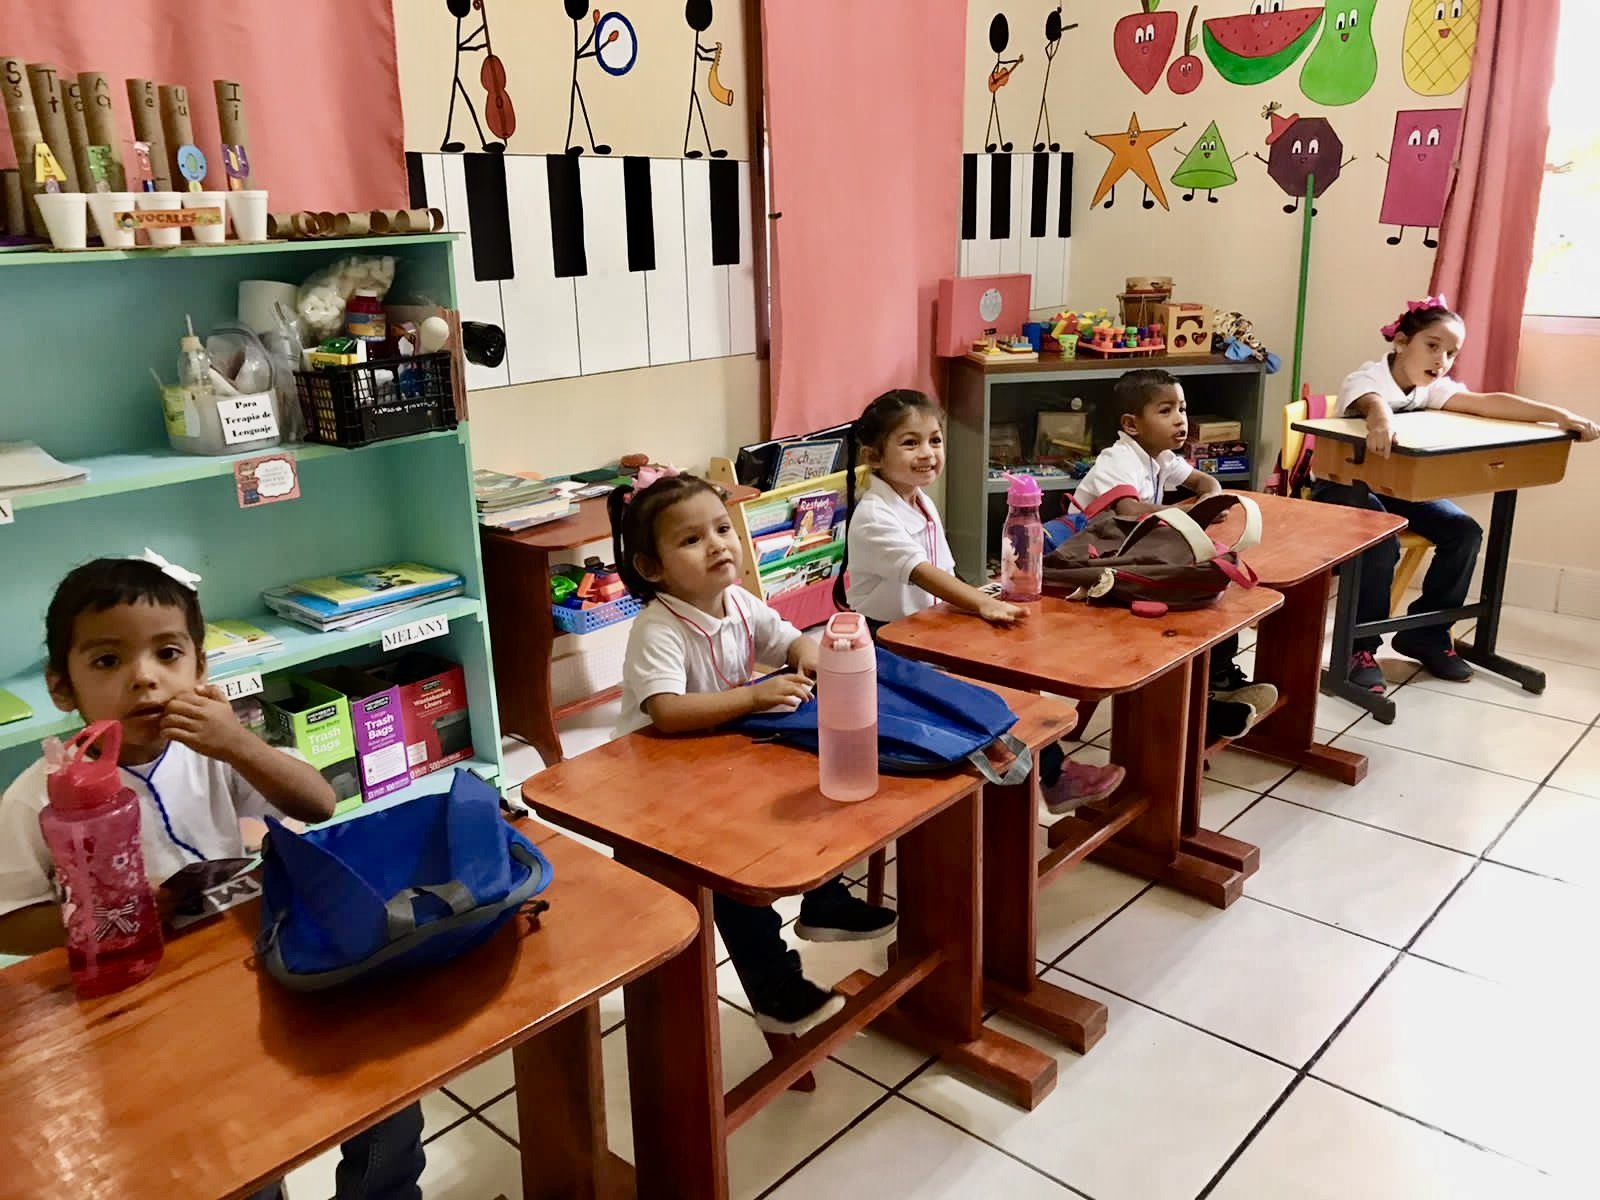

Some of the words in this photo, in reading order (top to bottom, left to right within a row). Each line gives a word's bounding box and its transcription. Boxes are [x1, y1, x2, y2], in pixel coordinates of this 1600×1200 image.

[6, 60, 22, 84] S
[35, 69, 56, 92] T
[175, 88, 185, 102] U
[226, 83, 241, 102] I
[48, 96, 59, 113] t
[34, 142, 68, 182] A
[86, 143, 112, 181] E
[177, 144, 207, 181] O
[221, 144, 249, 180] U
[135, 212, 196, 224] VOCALES
[235, 401, 257, 409] Para
[225, 413, 260, 424] Terapia
[232, 425, 272, 437] Lenguaje
[384, 618, 446, 648] MELANY
[221, 678, 262, 697] ELA
[365, 713, 394, 730] Trash
[308, 727, 341, 744] Trash
[368, 725, 394, 740] Bags
[311, 739, 341, 754] Bags
